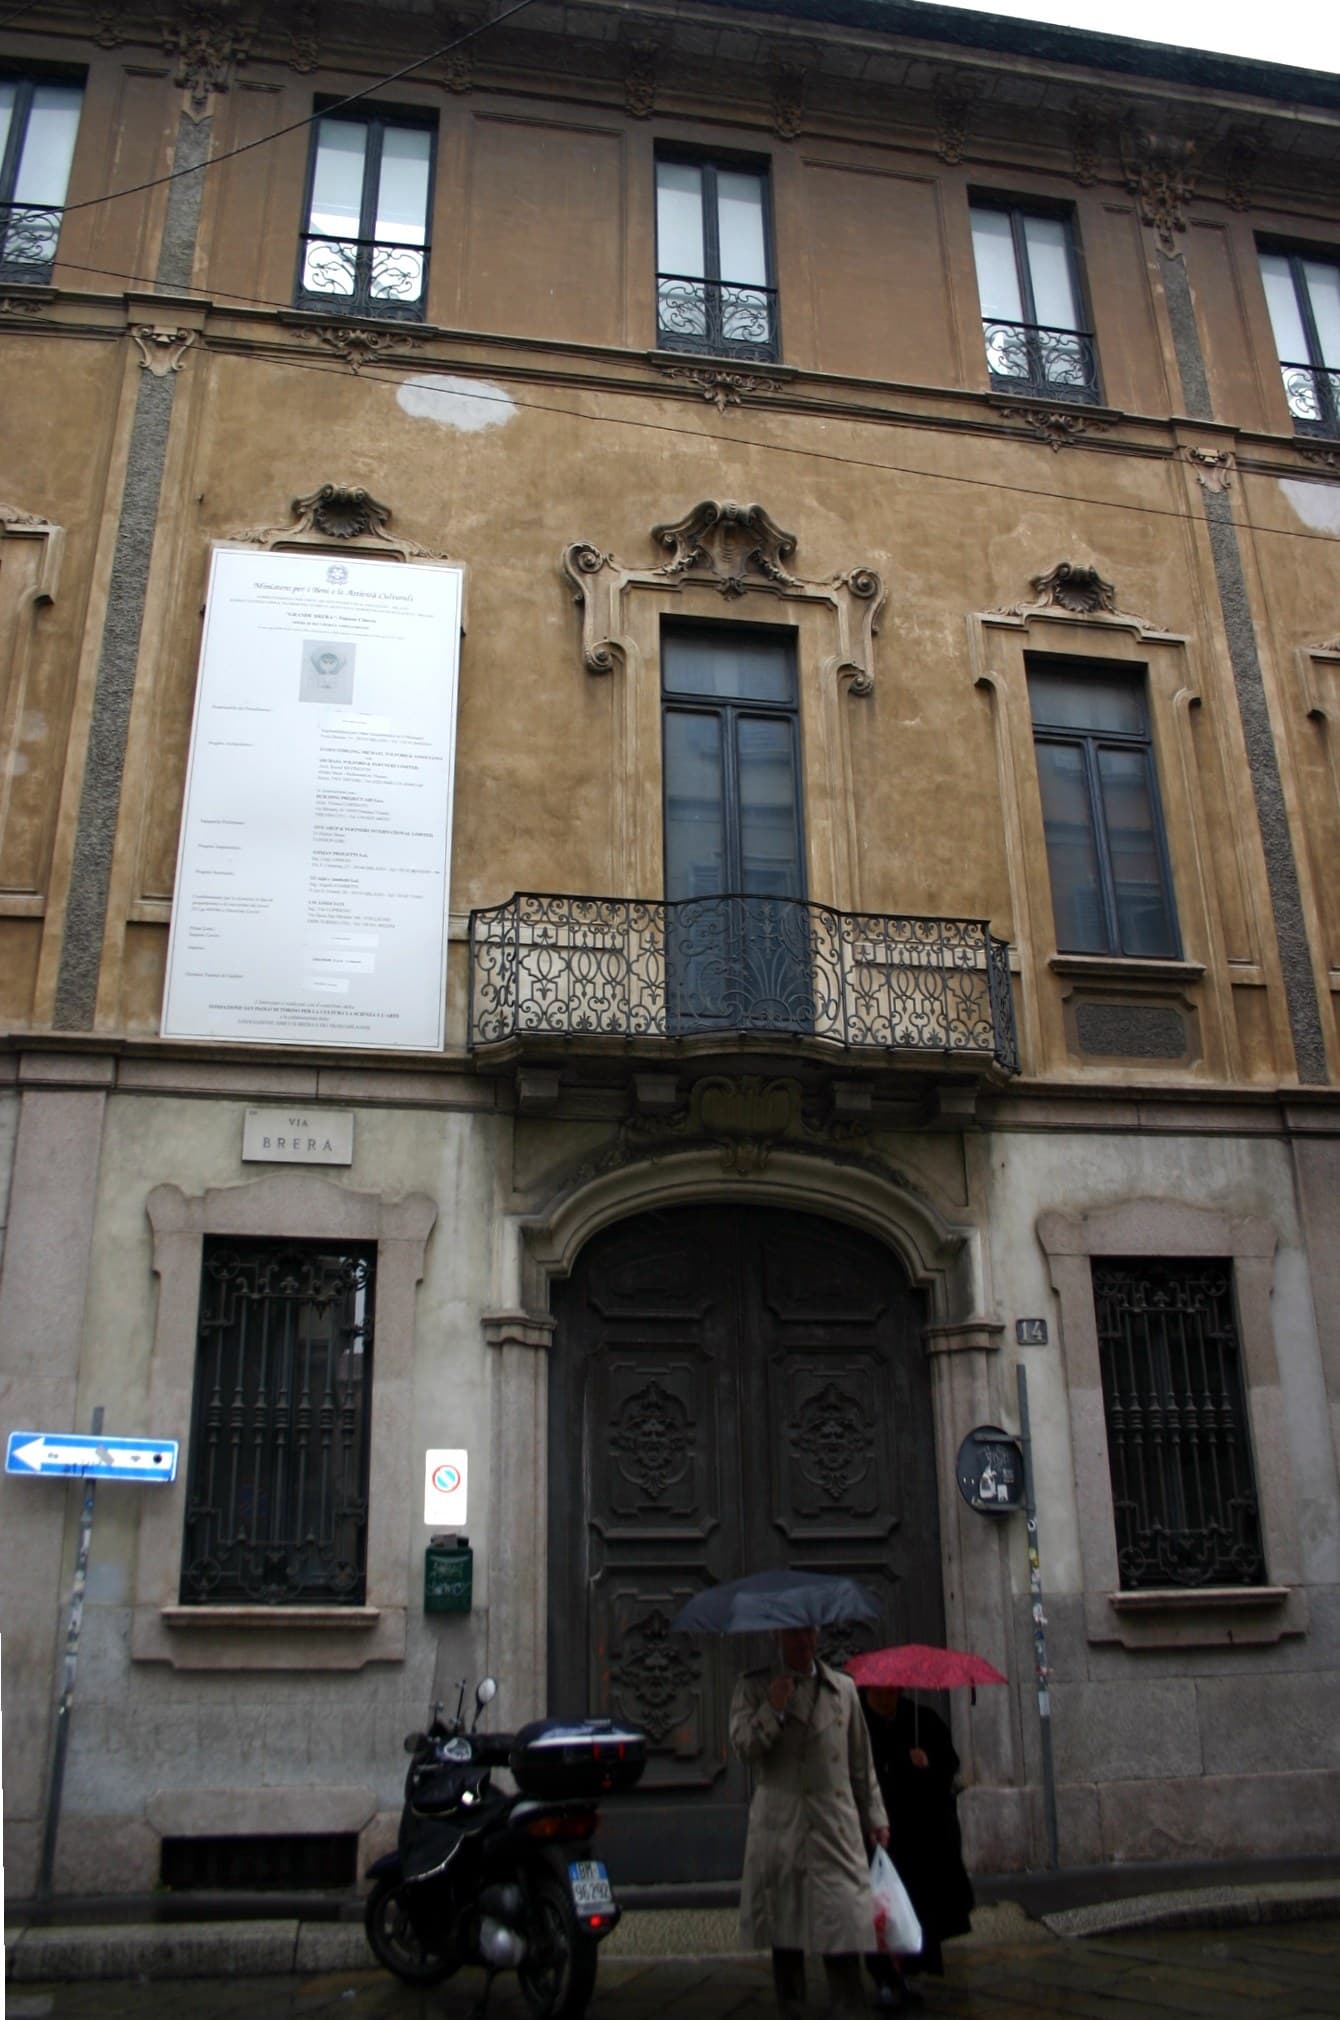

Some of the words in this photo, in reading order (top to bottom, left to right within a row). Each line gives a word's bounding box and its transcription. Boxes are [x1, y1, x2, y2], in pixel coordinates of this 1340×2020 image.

[289, 1118, 309, 1127] VIA
[262, 1136, 333, 1152] BRERA
[1021, 1320, 1043, 1341] 14
